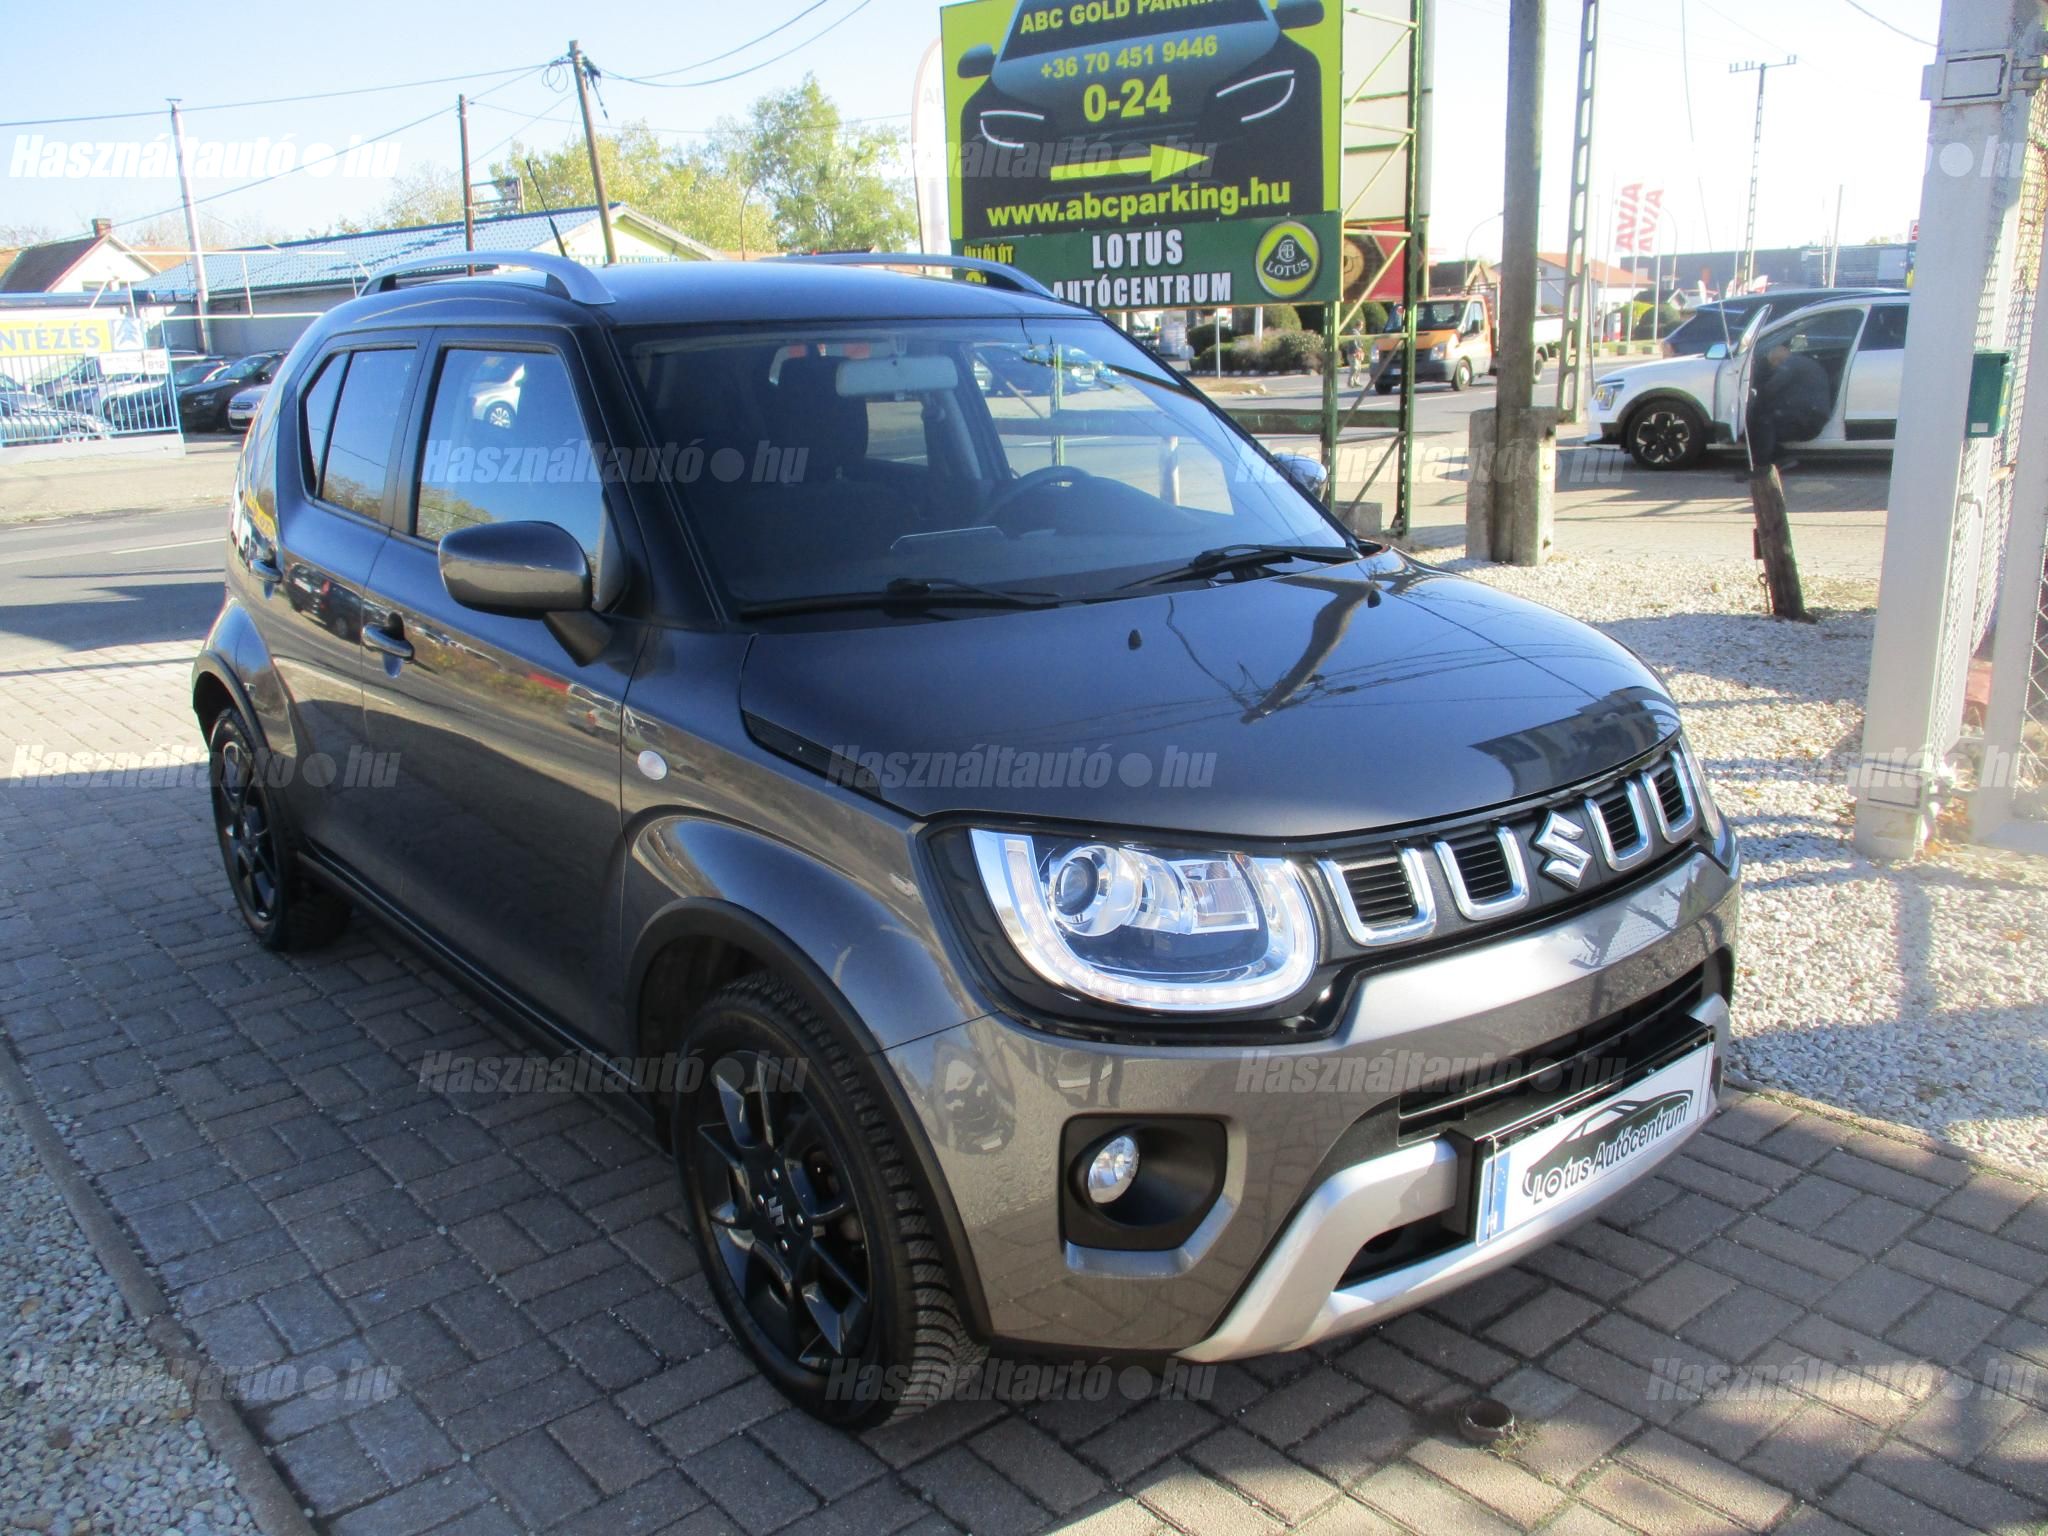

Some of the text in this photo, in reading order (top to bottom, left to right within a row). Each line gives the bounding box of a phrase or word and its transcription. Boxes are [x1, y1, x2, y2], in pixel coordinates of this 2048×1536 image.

[1020, 8, 1064, 34] ABC
[1069, 0, 1131, 25] GOLD
[1041, 34, 1218, 79] +36 70 451 9446
[1083, 74, 1172, 122] 0-24
[986, 176, 1291, 227] www.abcparking.hu
[1092, 229, 1184, 269] LOTUS
[1265, 258, 1310, 276] LOTUS
[1533, 1154, 1592, 1205] Lotus
